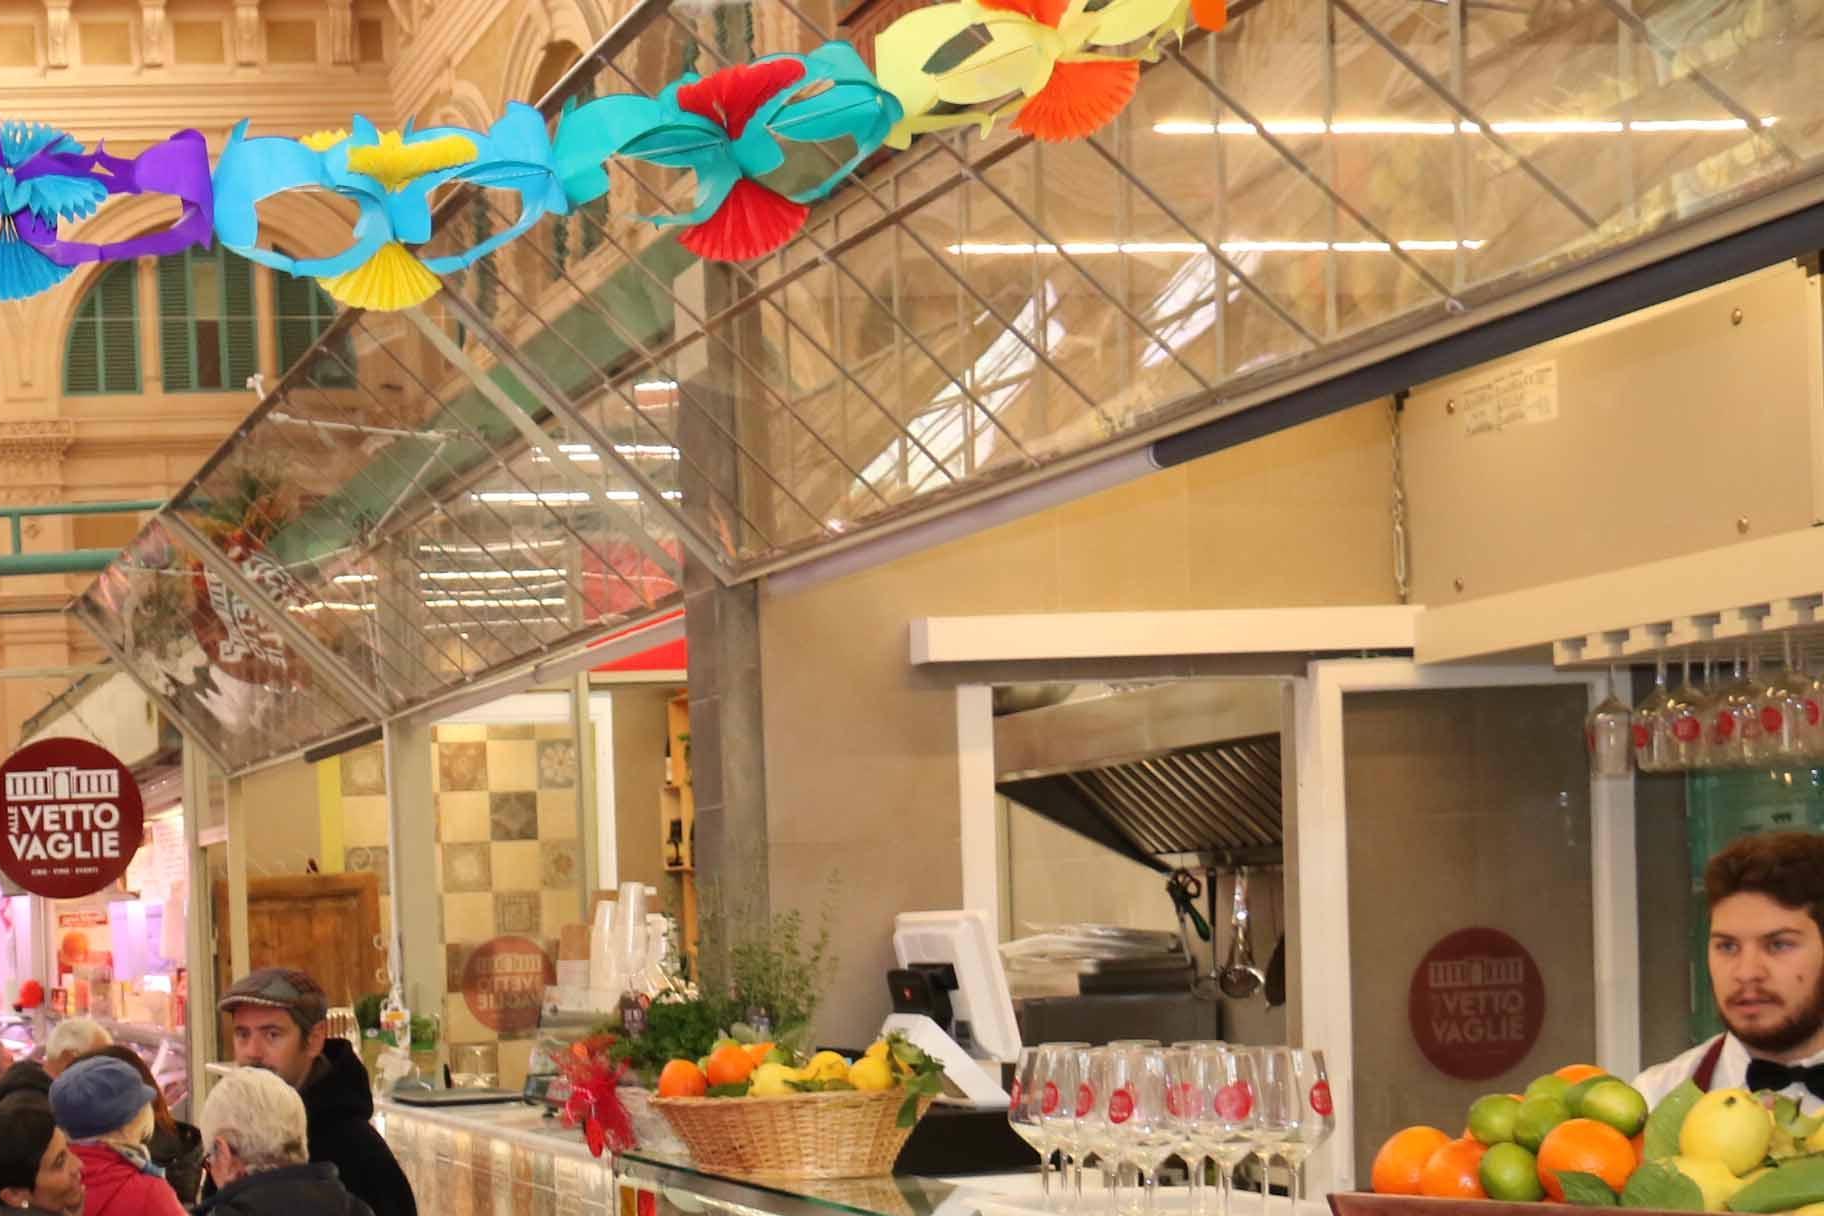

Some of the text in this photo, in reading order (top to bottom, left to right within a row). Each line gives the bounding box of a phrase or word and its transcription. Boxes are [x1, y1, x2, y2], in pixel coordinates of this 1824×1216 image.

[7, 802, 120, 835] ALLE VETTO
[7, 830, 121, 861] VAGLIE
[1441, 989, 1523, 1017] VETTO
[1430, 1015, 1525, 1044] VAGLIE
